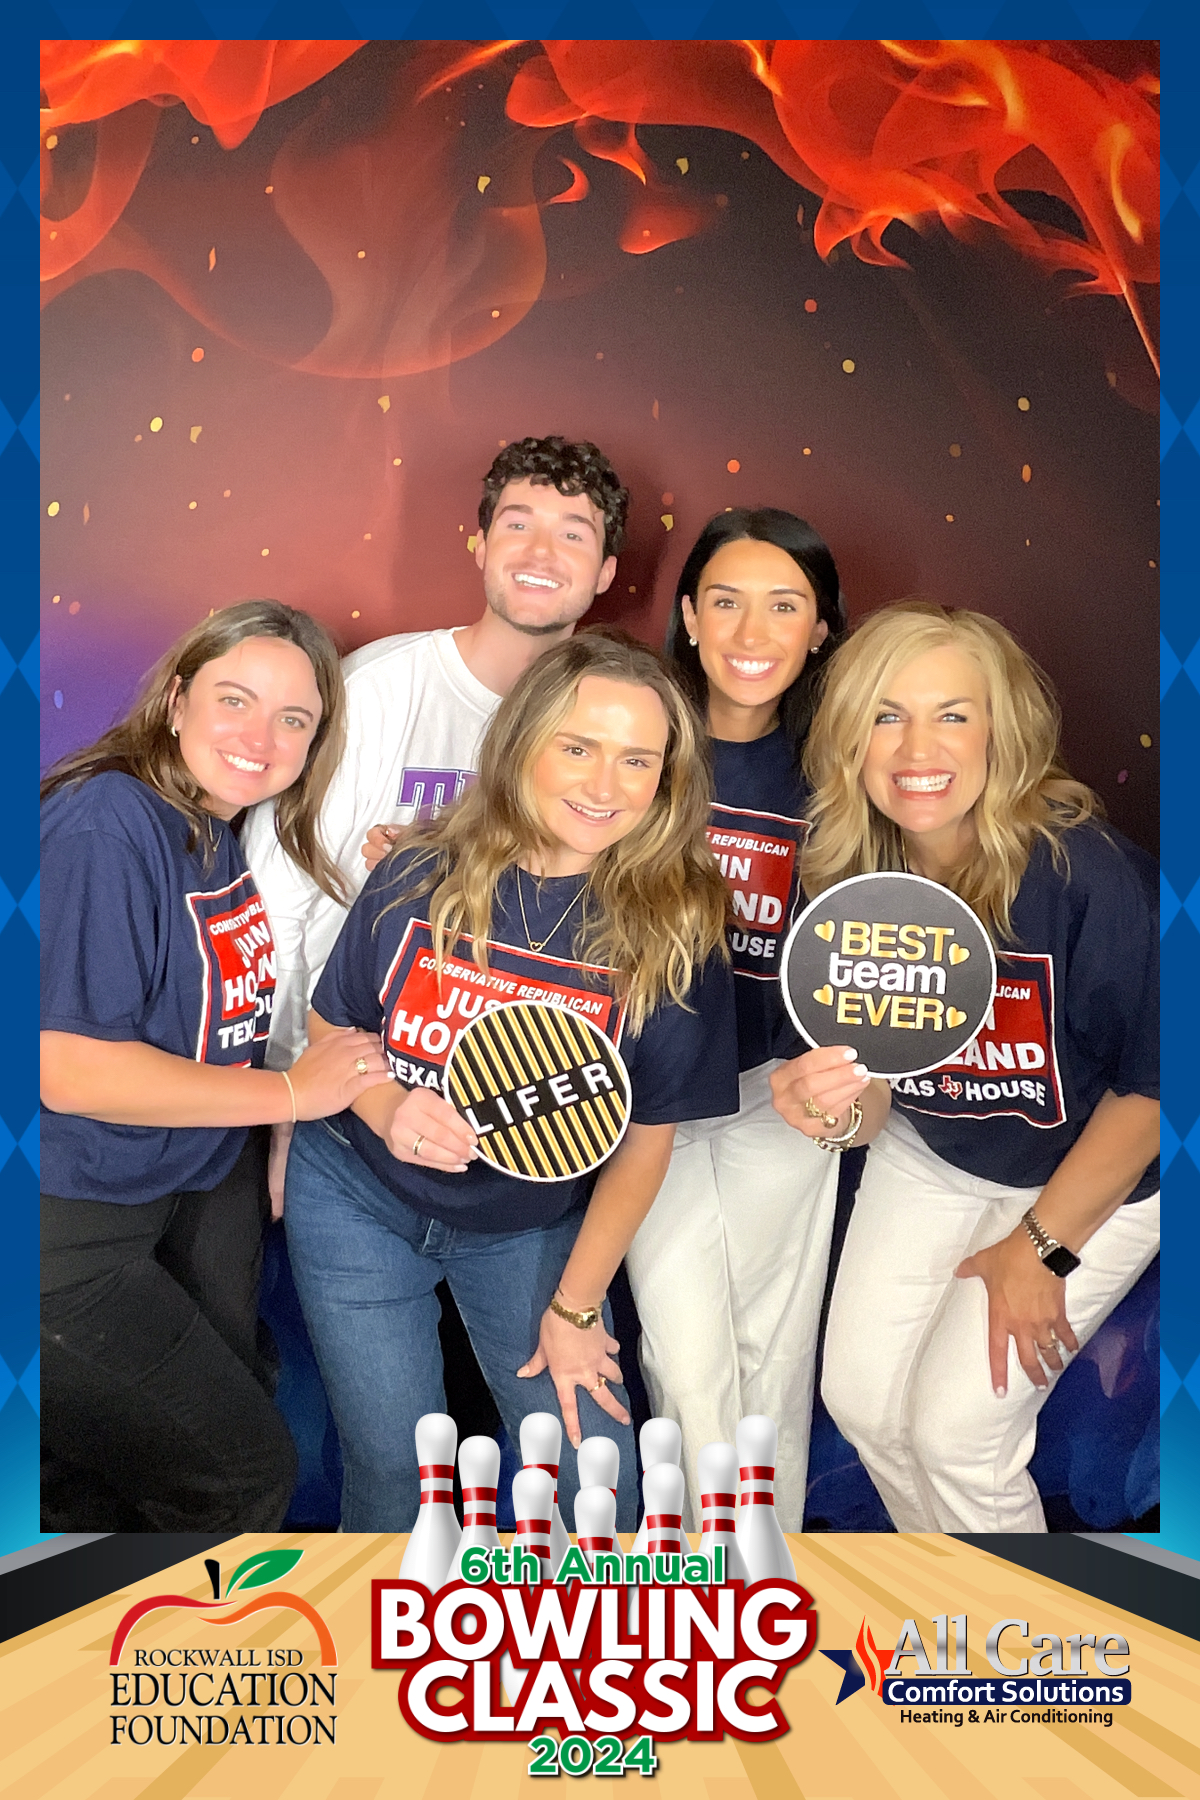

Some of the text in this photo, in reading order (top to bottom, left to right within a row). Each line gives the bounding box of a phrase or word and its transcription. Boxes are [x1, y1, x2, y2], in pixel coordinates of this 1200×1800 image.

[712, 833, 790, 857] REPUBLICAN
[840, 921, 954, 962] BEST
[829, 952, 947, 994] team
[517, 984, 603, 1015] REPUBLICAN
[836, 991, 944, 1031] EVER
[465, 1062, 614, 1135] LIFER
[965, 1080, 1046, 1106] HOUSE
